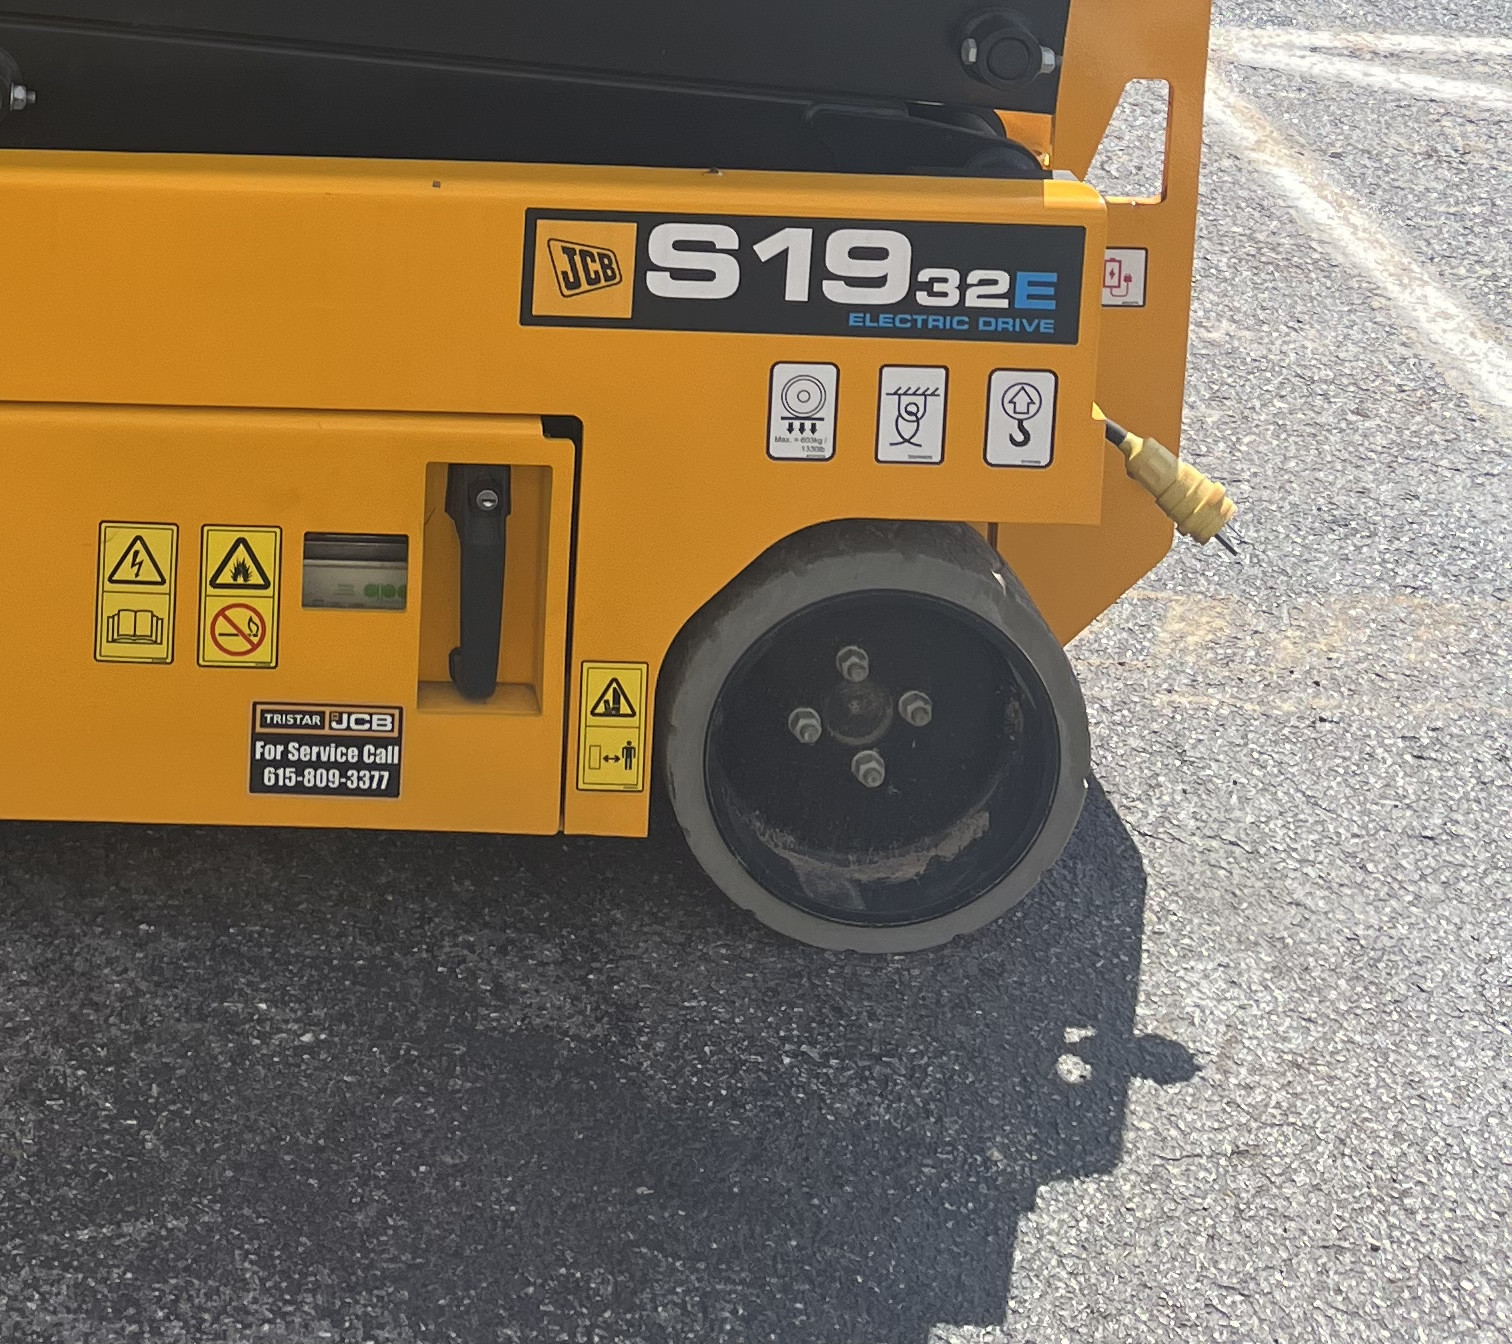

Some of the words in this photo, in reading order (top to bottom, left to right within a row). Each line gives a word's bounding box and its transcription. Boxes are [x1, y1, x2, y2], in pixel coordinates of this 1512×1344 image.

[560, 244, 618, 292] JCB
[848, 312, 970, 331] ELECTRIC
[978, 317, 1056, 334] DRIVE
[264, 713, 321, 726] TRISTAR
[331, 712, 393, 731] JCB
[255, 740, 285, 761] For
[287, 741, 359, 763] Service
[362, 744, 400, 765] Call
[263, 766, 390, 790] 615-809-3377
